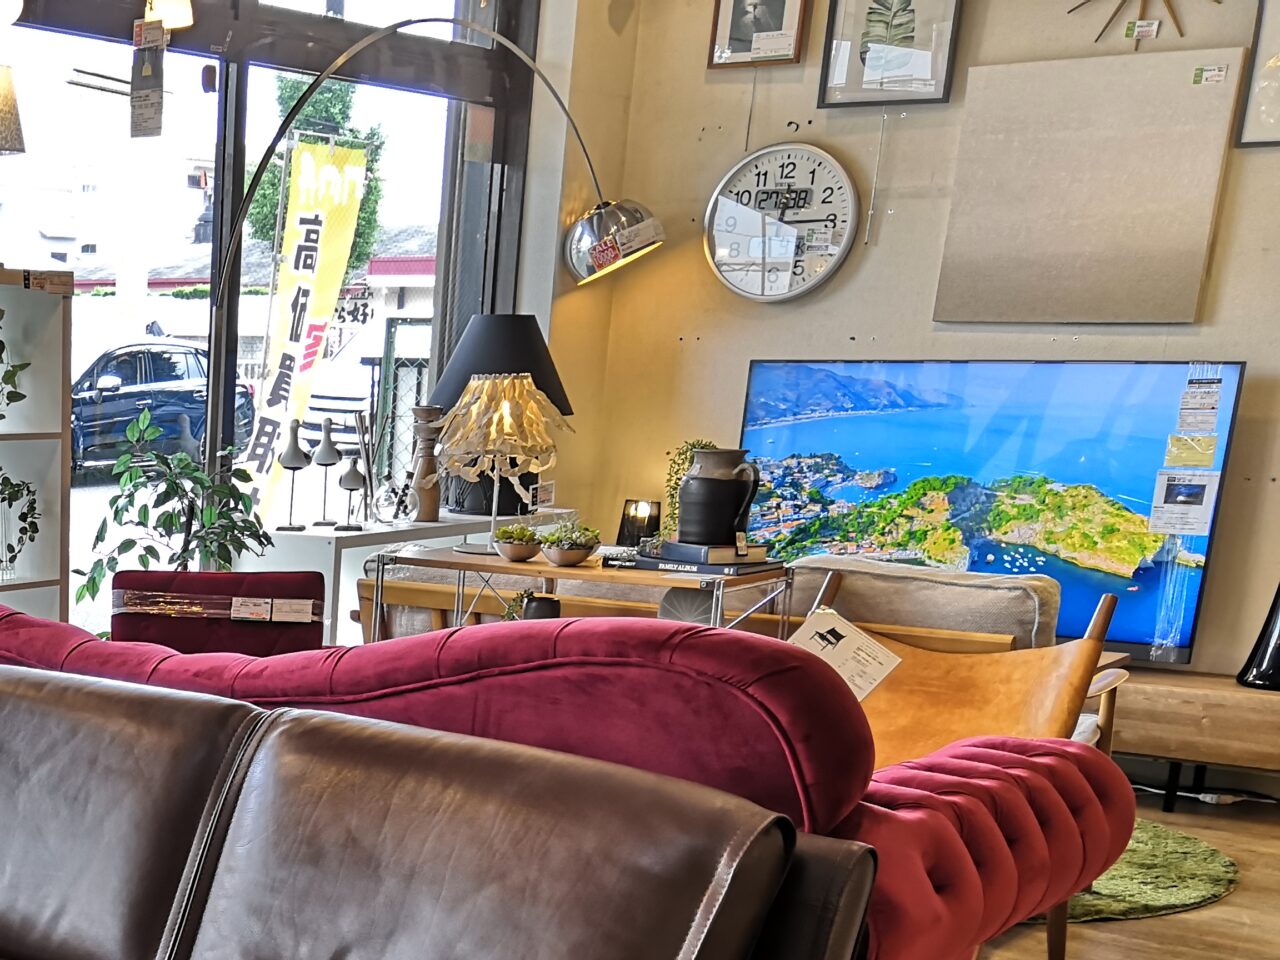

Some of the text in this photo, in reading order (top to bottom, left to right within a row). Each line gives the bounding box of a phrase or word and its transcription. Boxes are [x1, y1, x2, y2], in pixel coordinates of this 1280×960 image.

[755, 170, 768, 187] 11
[779, 162, 796, 179] 12
[809, 168, 816, 185] 1
[733, 190, 752, 206] 10
[821, 187, 834, 204] 2
[725, 216, 737, 232] 9
[824, 213, 837, 229] 3
[729, 242, 741, 258] 8
[767, 267, 779, 283] 6
[792, 260, 805, 276] 5
[658, 563, 678, 571] FAMILY
